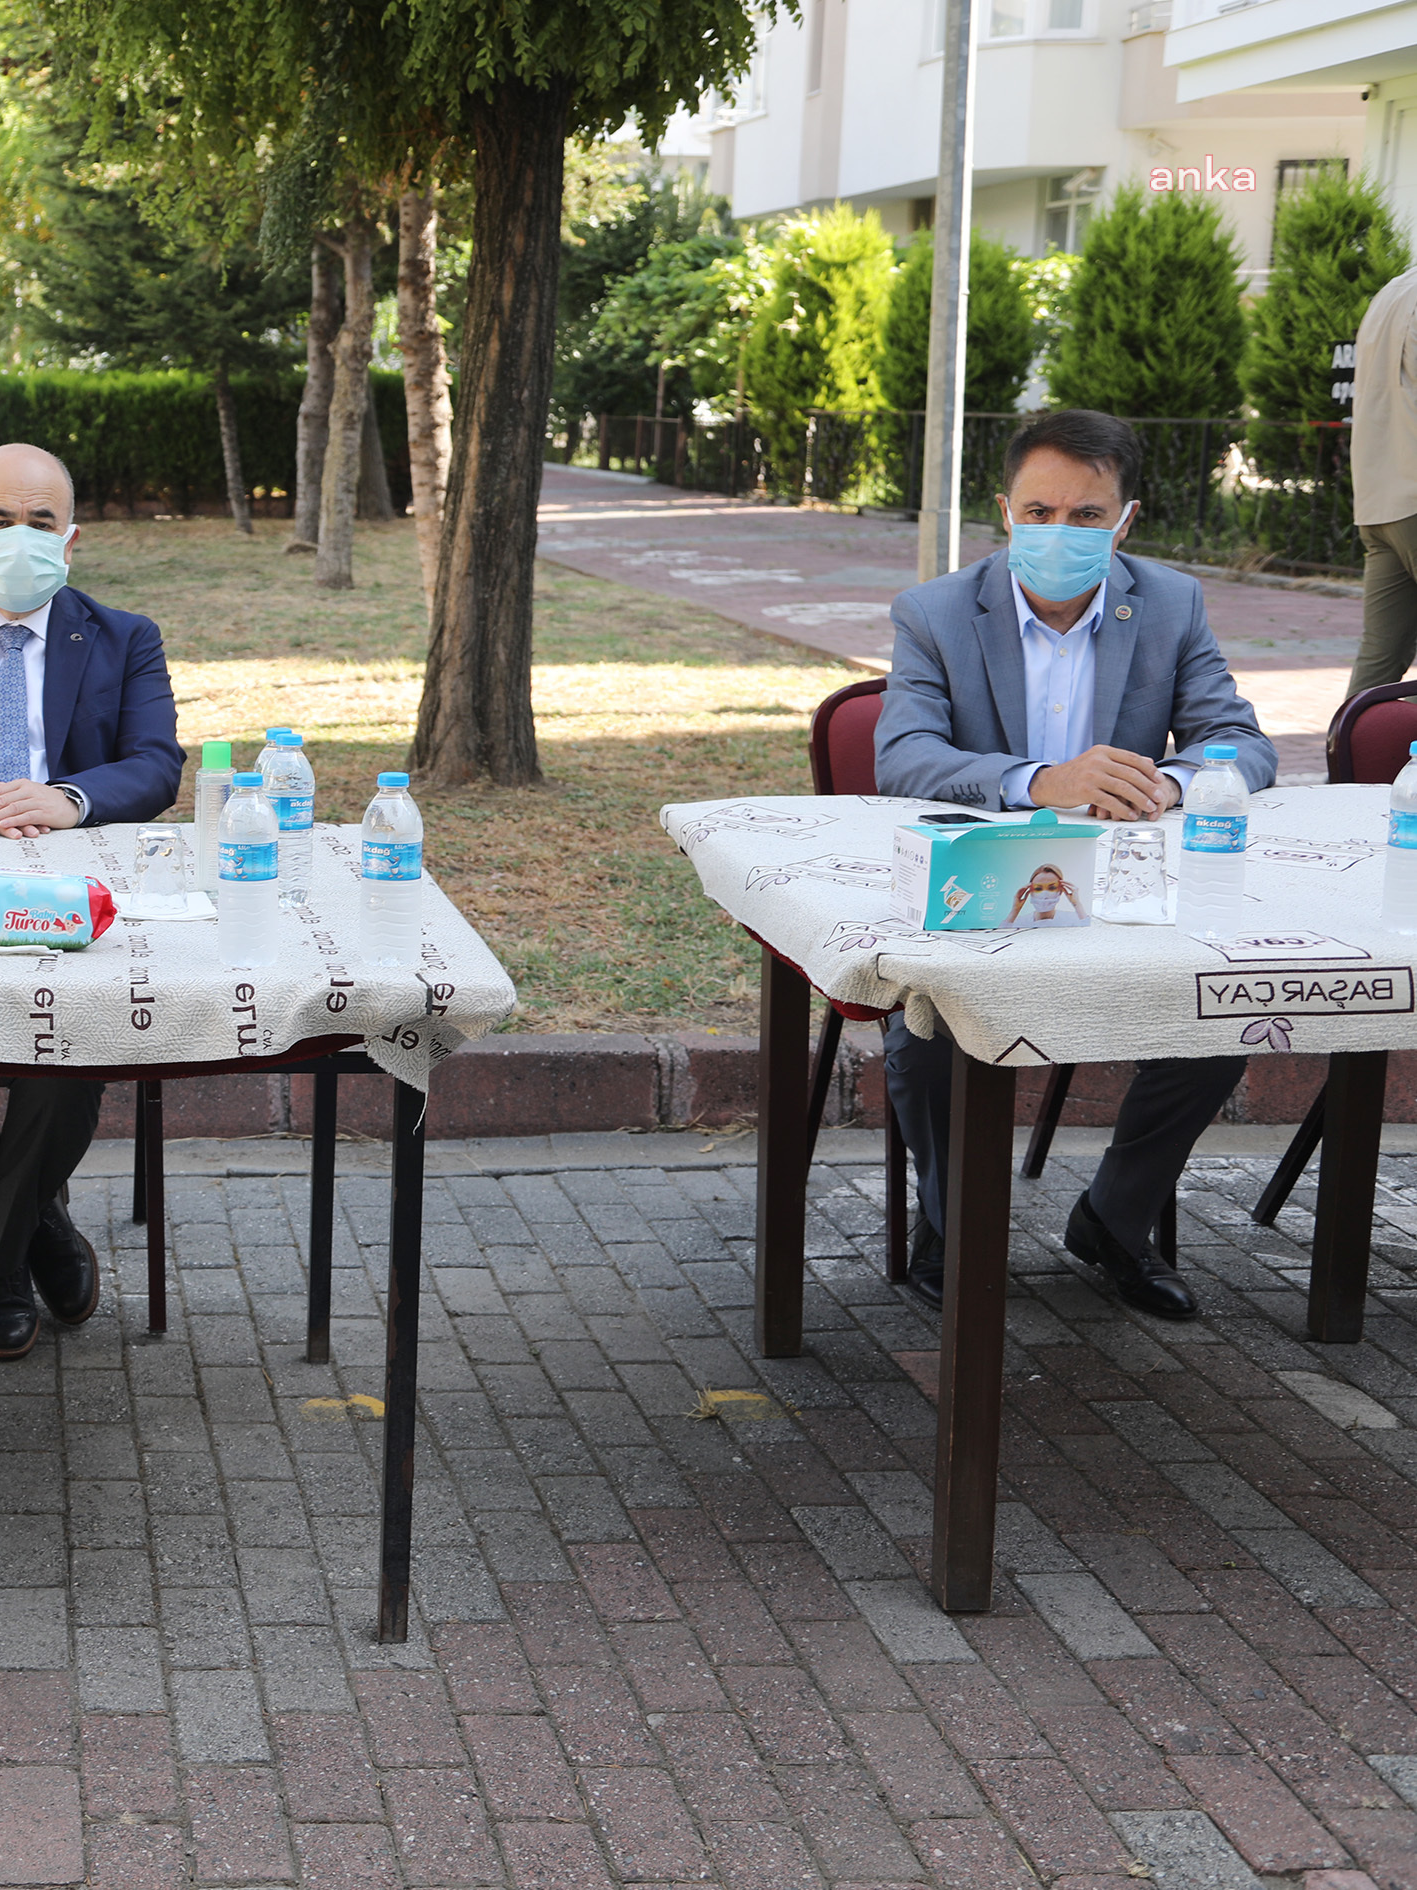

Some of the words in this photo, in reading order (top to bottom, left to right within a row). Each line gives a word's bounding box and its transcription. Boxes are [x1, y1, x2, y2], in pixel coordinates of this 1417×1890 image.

[1196, 819, 1232, 830] akdağ
[5, 909, 49, 932] Turco
[30, 910, 57, 922] Baby
